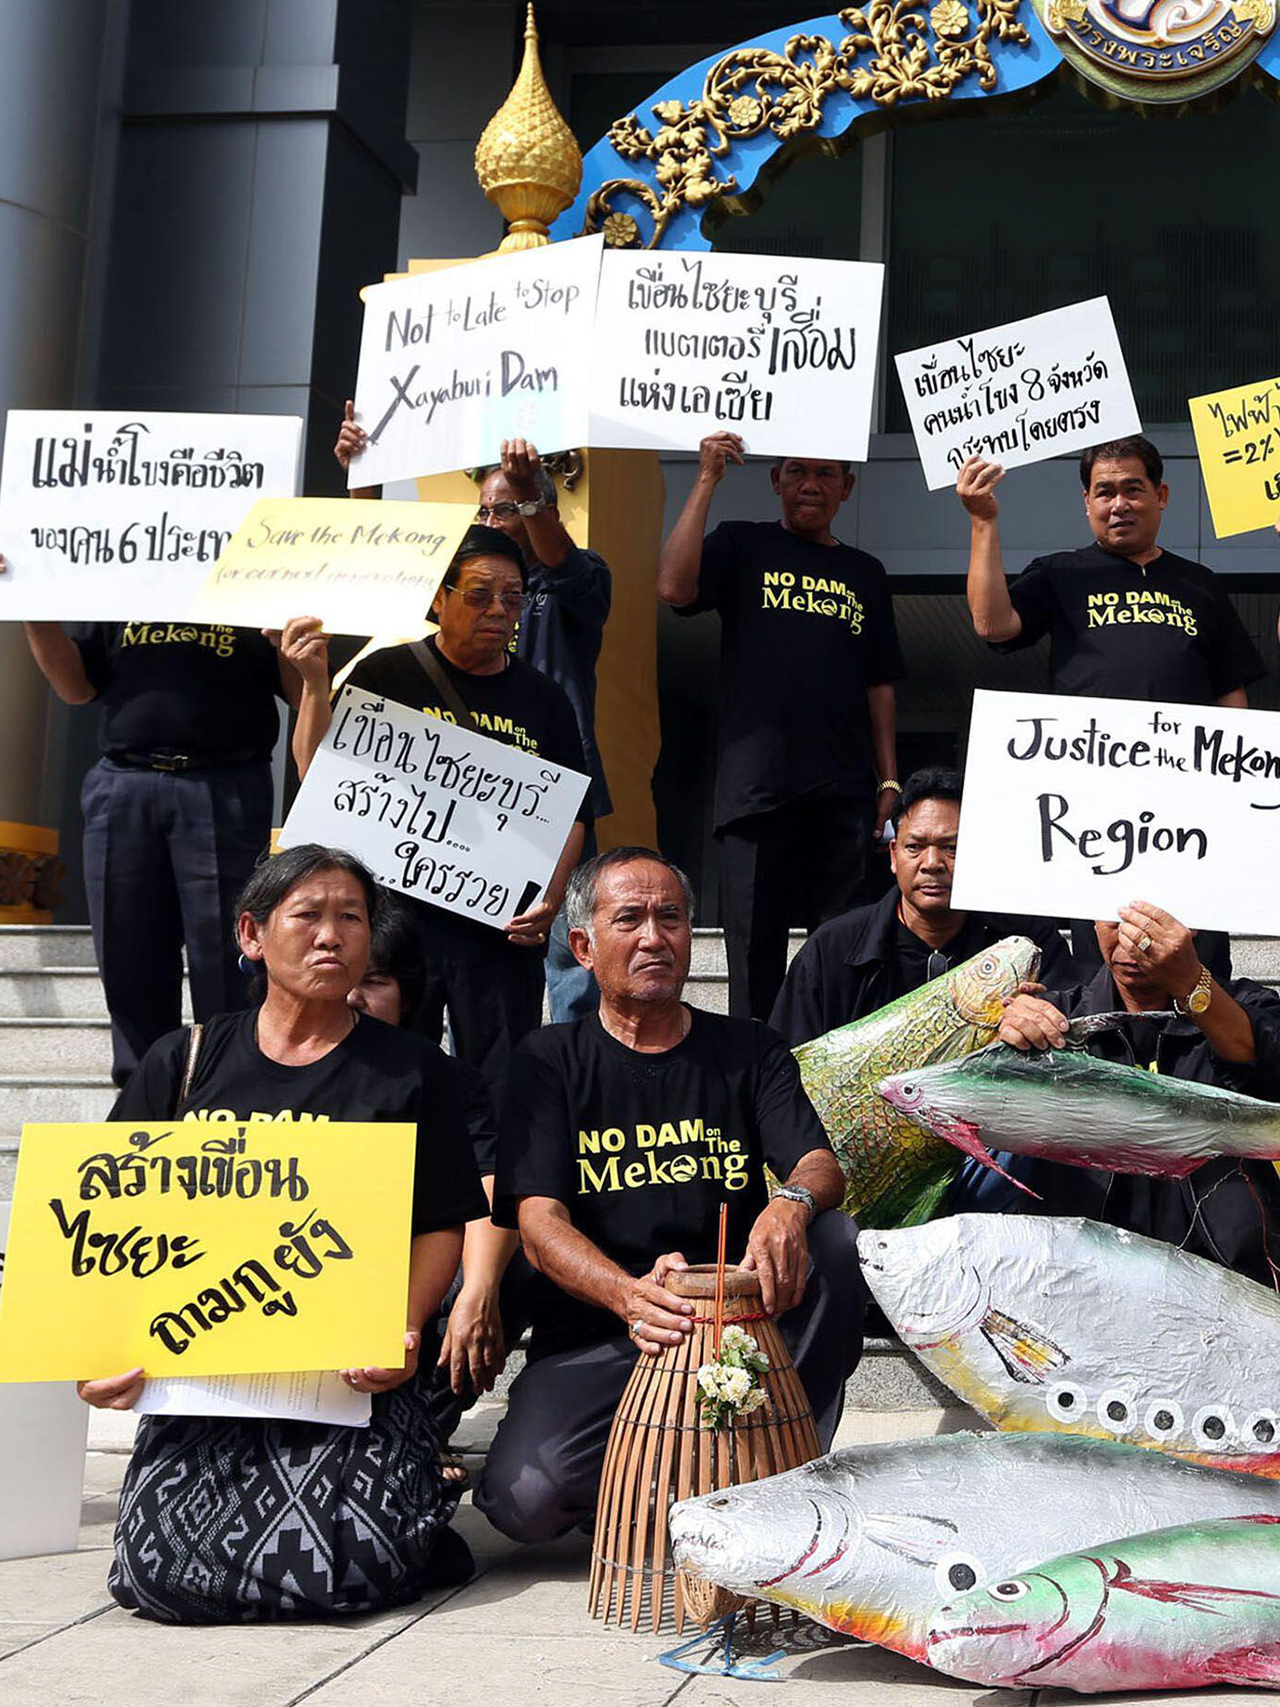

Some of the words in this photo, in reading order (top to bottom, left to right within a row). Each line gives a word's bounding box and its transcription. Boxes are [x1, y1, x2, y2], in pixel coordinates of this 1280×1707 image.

[1076, 18, 1242, 68] ทรงพระเจริญ
[385, 303, 436, 352] Not
[446, 299, 461, 326] to
[463, 291, 507, 332] Late
[514, 280, 529, 299] to
[525, 278, 580, 316] Stop
[368, 364, 492, 446] Xayaburi
[501, 351, 558, 398] Dam
[1020, 368, 1045, 401] 8
[145, 512, 232, 562] ประเท
[247, 517, 304, 549] Save
[310, 526, 340, 545] the
[351, 522, 447, 557] Mekong
[764, 572, 795, 586] NO
[802, 576, 847, 596] DAM
[1088, 592, 1119, 607] NO
[1125, 591, 1171, 606] DAM
[762, 587, 865, 635] Mekong
[1087, 605, 1198, 636] Mekong
[1007, 717, 1151, 768] Justice
[1148, 711, 1182, 735] for
[1154, 748, 1189, 772] the
[1035, 792, 1208, 876] Region
[579, 1127, 626, 1154] NO
[635, 1118, 705, 1148] DAM
[704, 1137, 741, 1154] The
[706, 1127, 721, 1137] on
[77, 1127, 309, 1201] สร้างเขื่อน
[576, 1150, 749, 1194] Mekong
